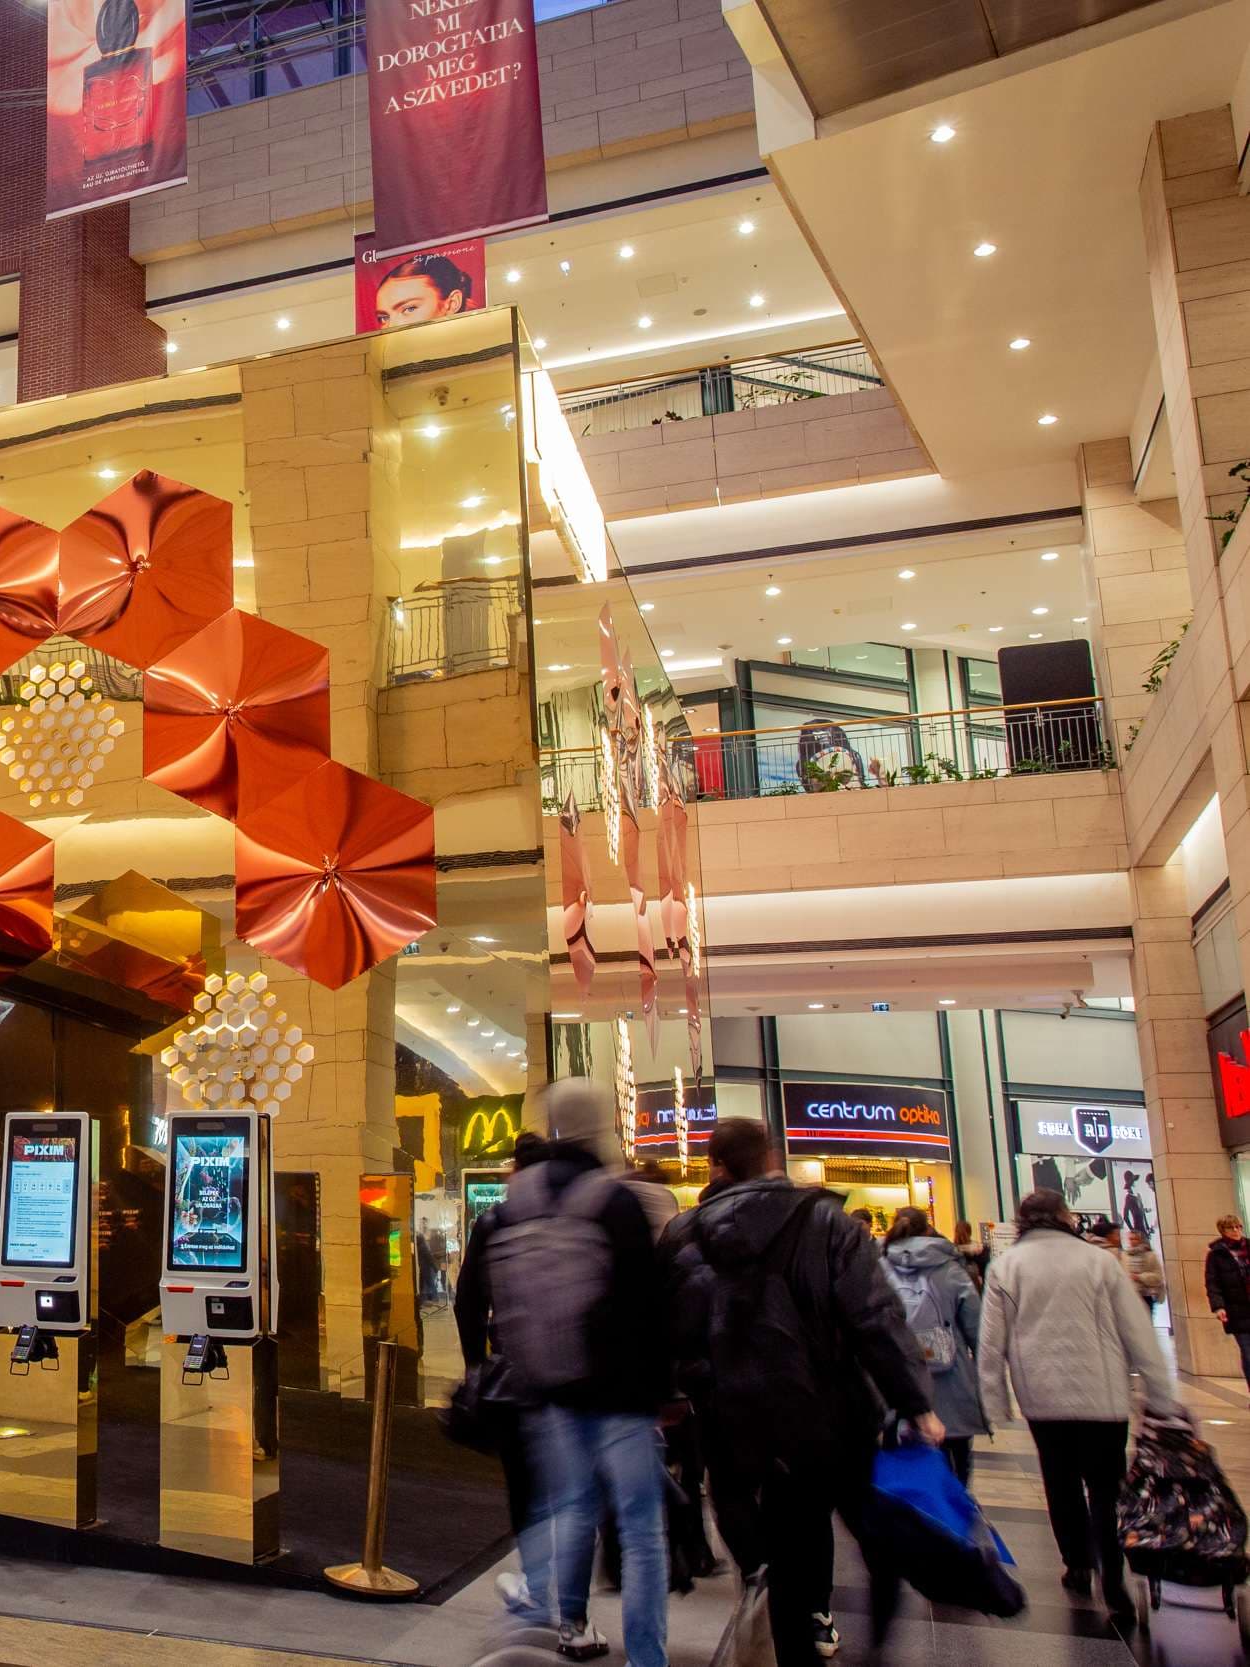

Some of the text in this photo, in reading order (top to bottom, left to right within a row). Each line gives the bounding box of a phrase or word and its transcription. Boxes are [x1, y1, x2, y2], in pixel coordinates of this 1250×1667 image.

[436, 13, 461, 35] MI
[377, 18, 525, 72] DOBOGTATJA
[426, 53, 477, 81] MEG
[384, 96, 401, 114] A
[807, 1101, 941, 1126] centrum optika
[23, 1145, 64, 1156] PIXIM
[190, 1156, 230, 1167] PIXIM
